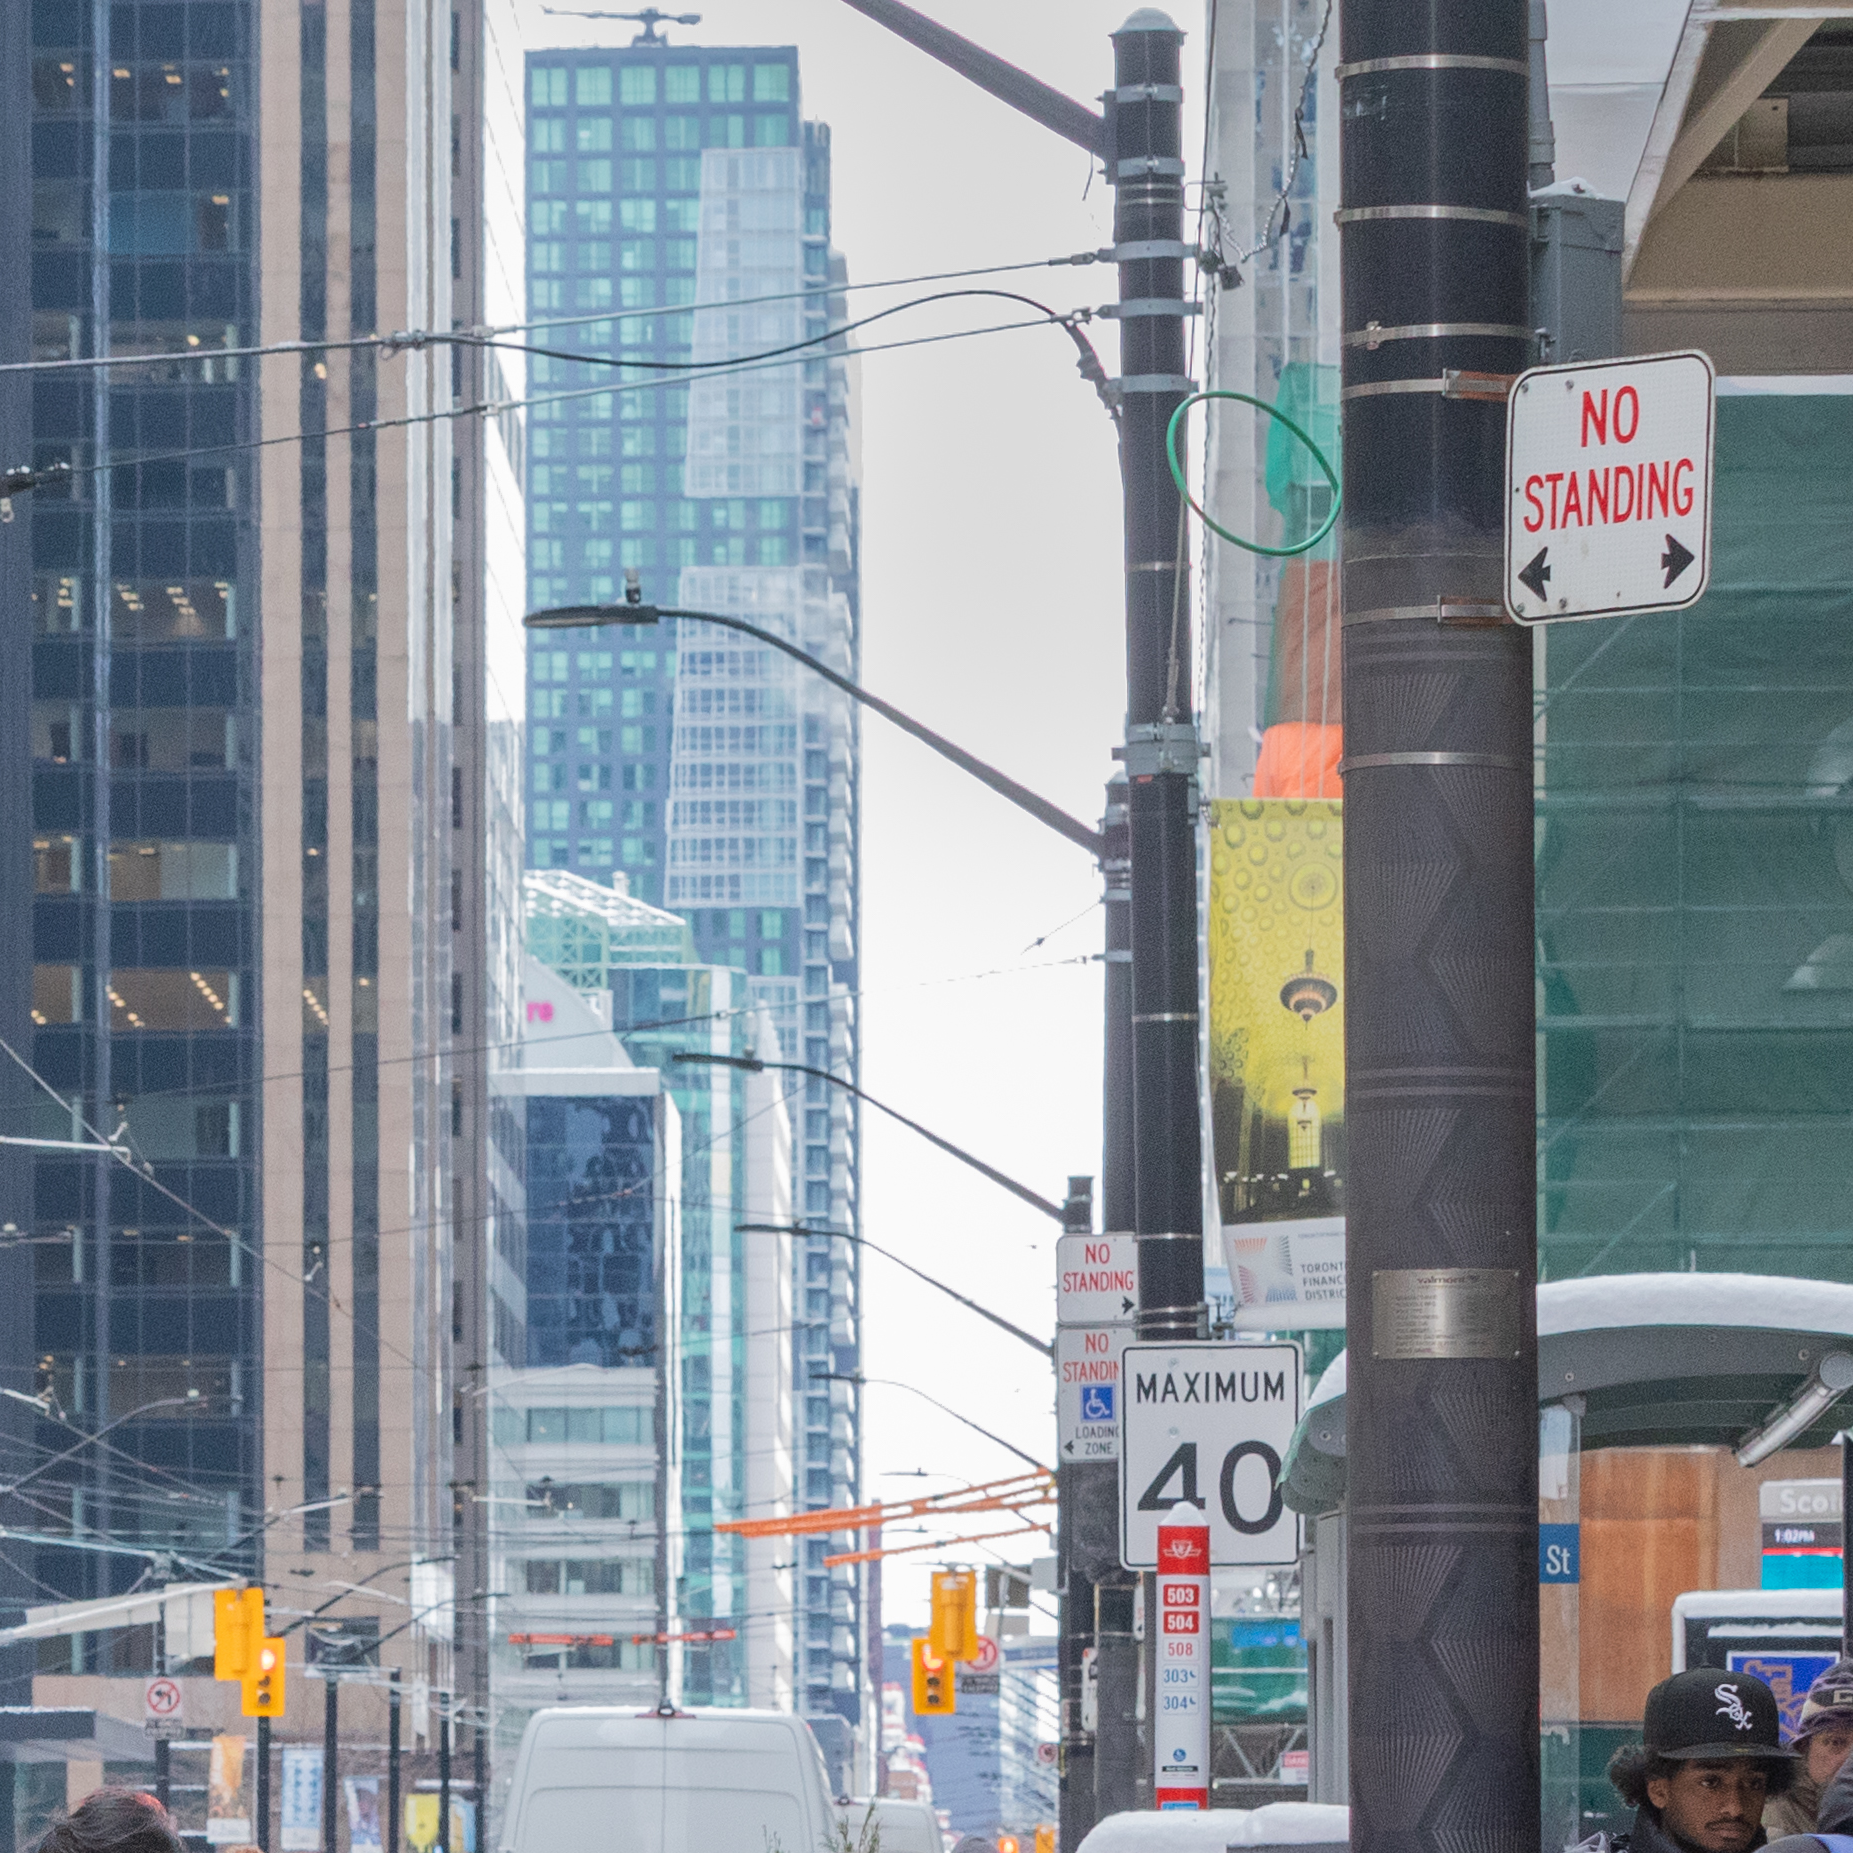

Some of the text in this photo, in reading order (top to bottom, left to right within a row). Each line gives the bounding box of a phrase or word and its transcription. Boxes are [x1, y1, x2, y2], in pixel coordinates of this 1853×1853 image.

[1581, 385, 1640, 448] NO
[1523, 457, 1694, 533] STANDING
[1084, 1243, 1110, 1265] NO
[1063, 1270, 1134, 1293] STANDING
[1084, 1333, 1110, 1354] NO
[1136, 1370, 1285, 1404] MAXIMUM
[1084, 1442, 1113, 1456] ZONE
[1137, 1439, 1284, 1535] 40
[1545, 1544, 1571, 1575] St
[1166, 1587, 1195, 1603] 503
[1166, 1615, 1195, 1630] 504
[1167, 1641, 1194, 1657] 508
[1163, 1669, 1190, 1684] 303
[1163, 1695, 1190, 1711] 304
